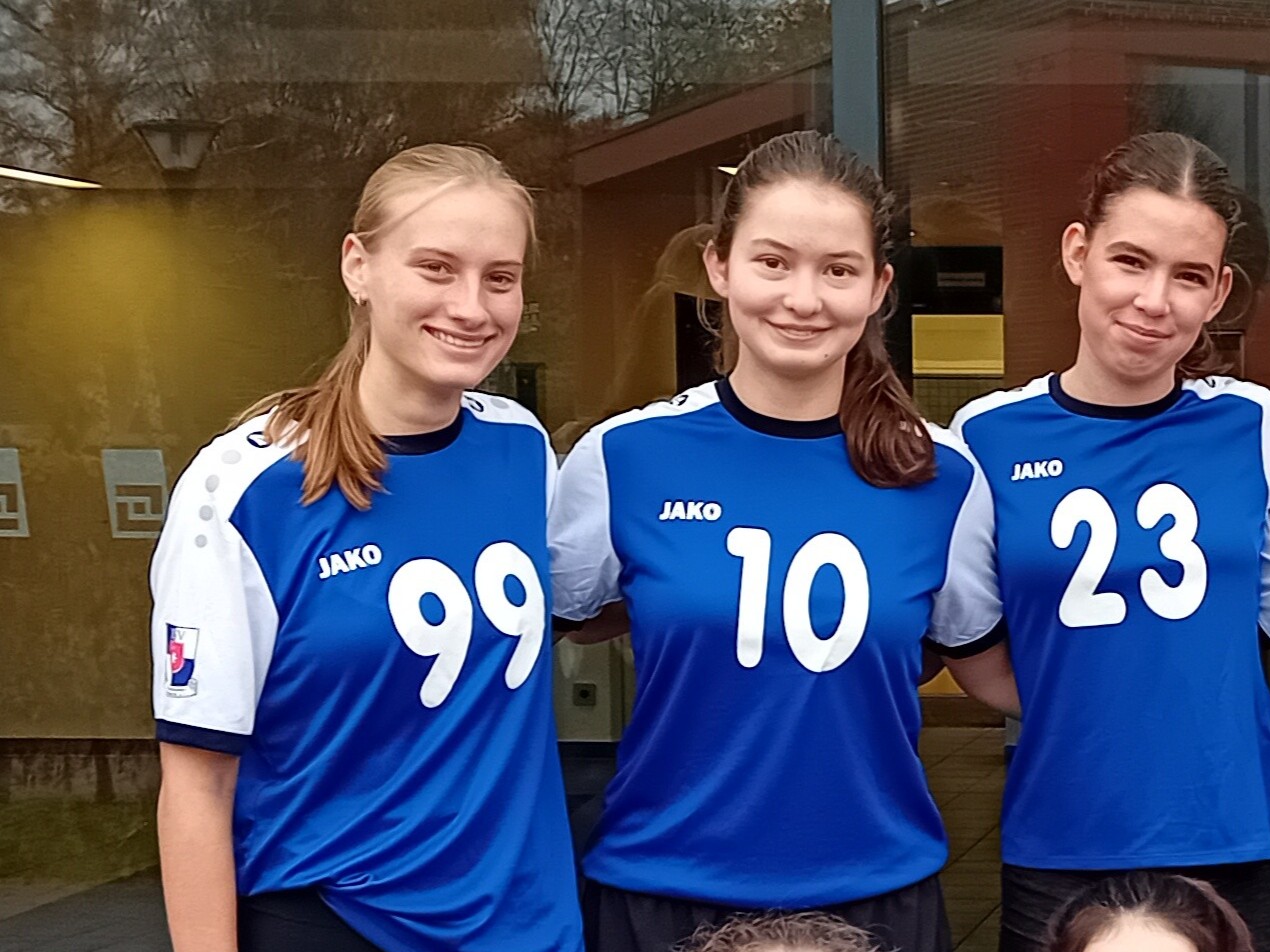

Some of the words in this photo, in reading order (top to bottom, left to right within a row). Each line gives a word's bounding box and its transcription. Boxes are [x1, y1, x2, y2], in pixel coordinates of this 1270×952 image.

[659, 501, 722, 521] JAKO
[1011, 459, 1063, 481] JAKO
[318, 544, 382, 580] JAKO
[726, 526, 870, 673] 10
[1050, 483, 1208, 628] 23
[387, 541, 545, 709] 99
